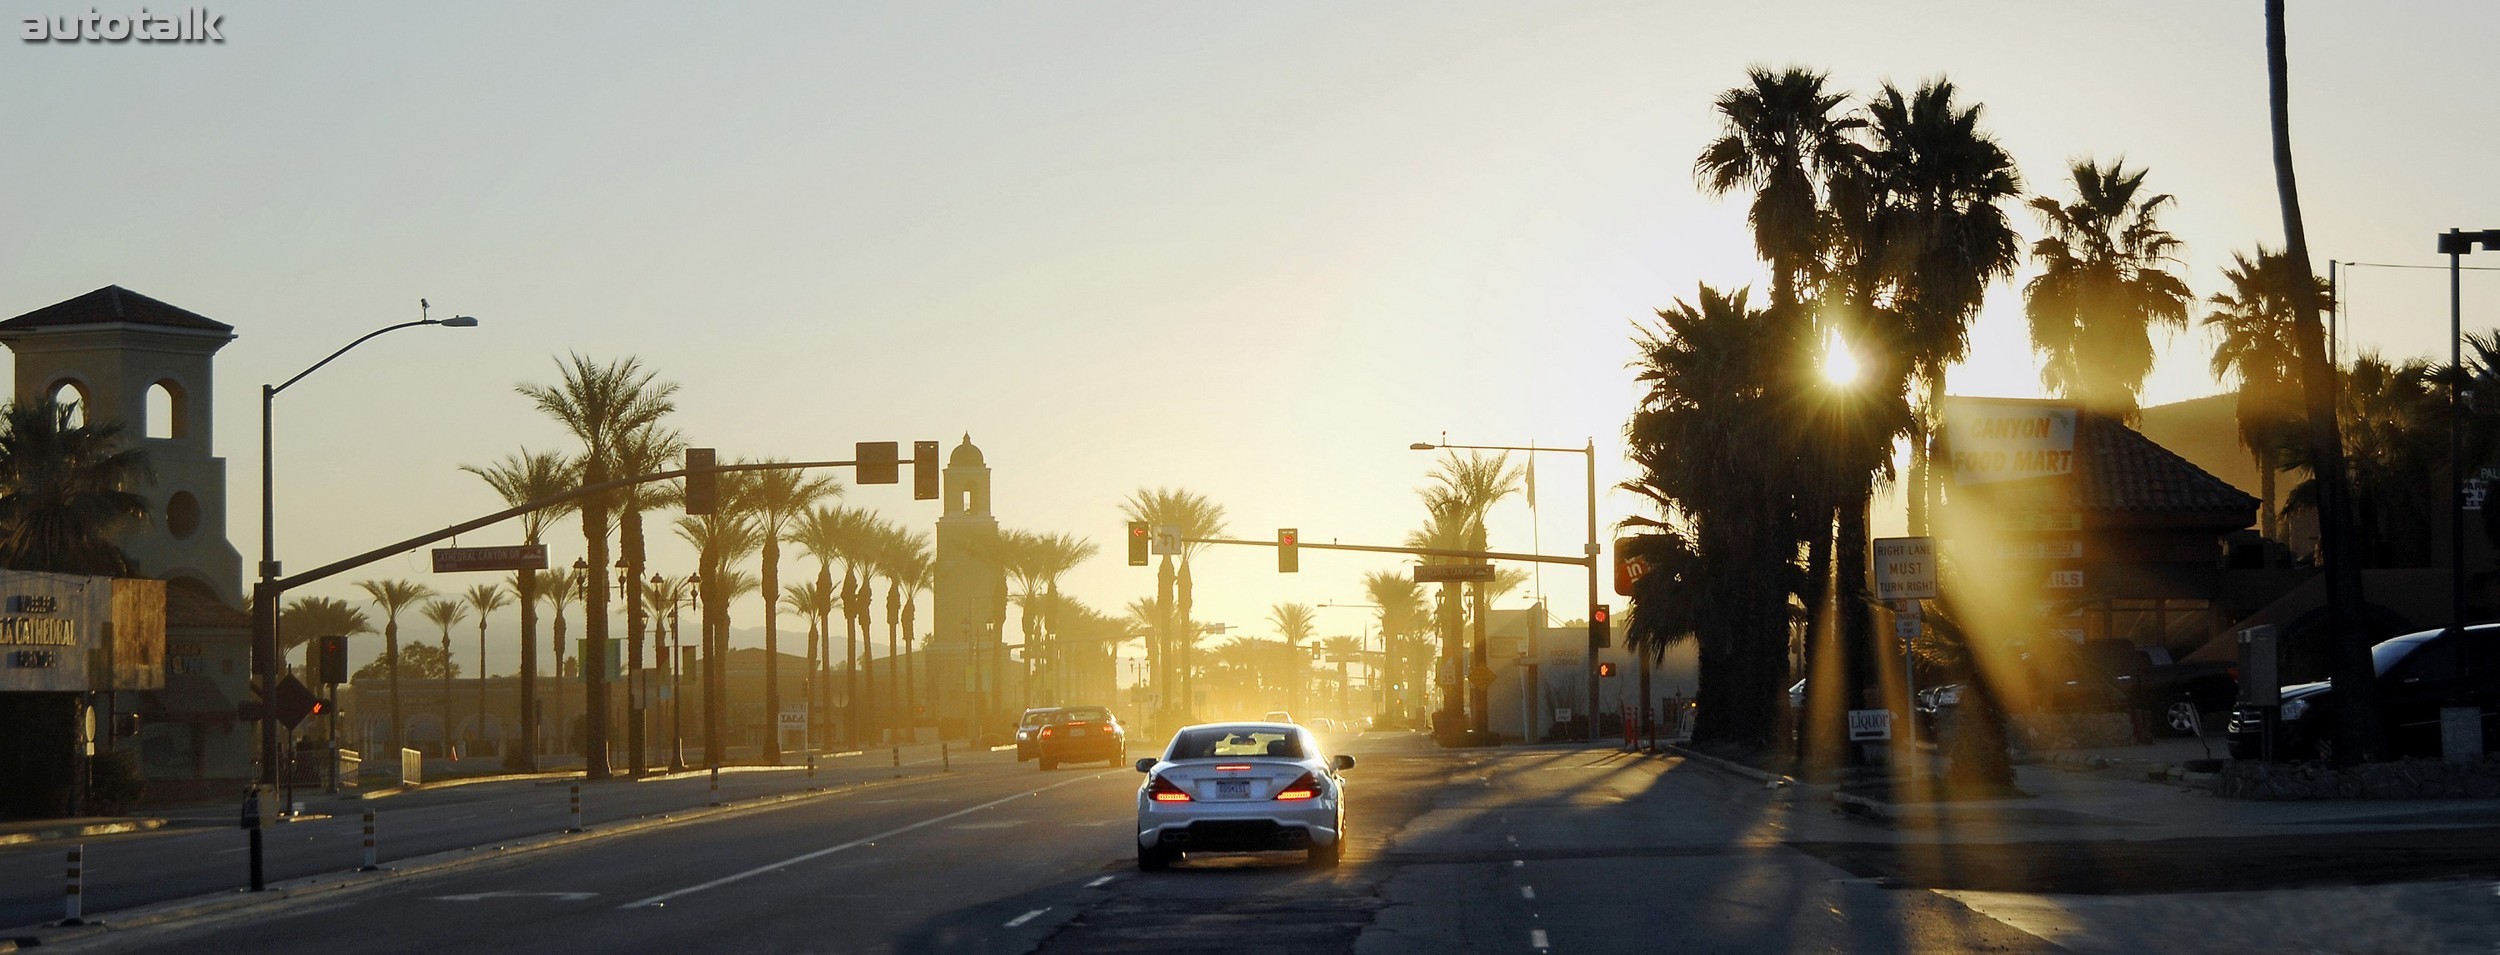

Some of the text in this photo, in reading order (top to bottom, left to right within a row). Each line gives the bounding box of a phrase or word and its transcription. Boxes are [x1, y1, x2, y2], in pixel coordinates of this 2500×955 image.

[1970, 416, 2051, 439] CANYON
[1953, 450, 2072, 473] FOOD MART
[436, 551, 477, 562] CATHEDRAL
[479, 550, 507, 561] CANYON
[1878, 545, 1932, 556] RIGHT LANE
[1890, 563, 1922, 575] MUST
[1880, 581, 1933, 592] TURN RIGHT
[1895, 601, 1906, 611] NO
[16, 618, 77, 646] CATHEDRAL
[1550, 649, 1581, 657] MOOSE
[1551, 658, 1579, 666] LODGE
